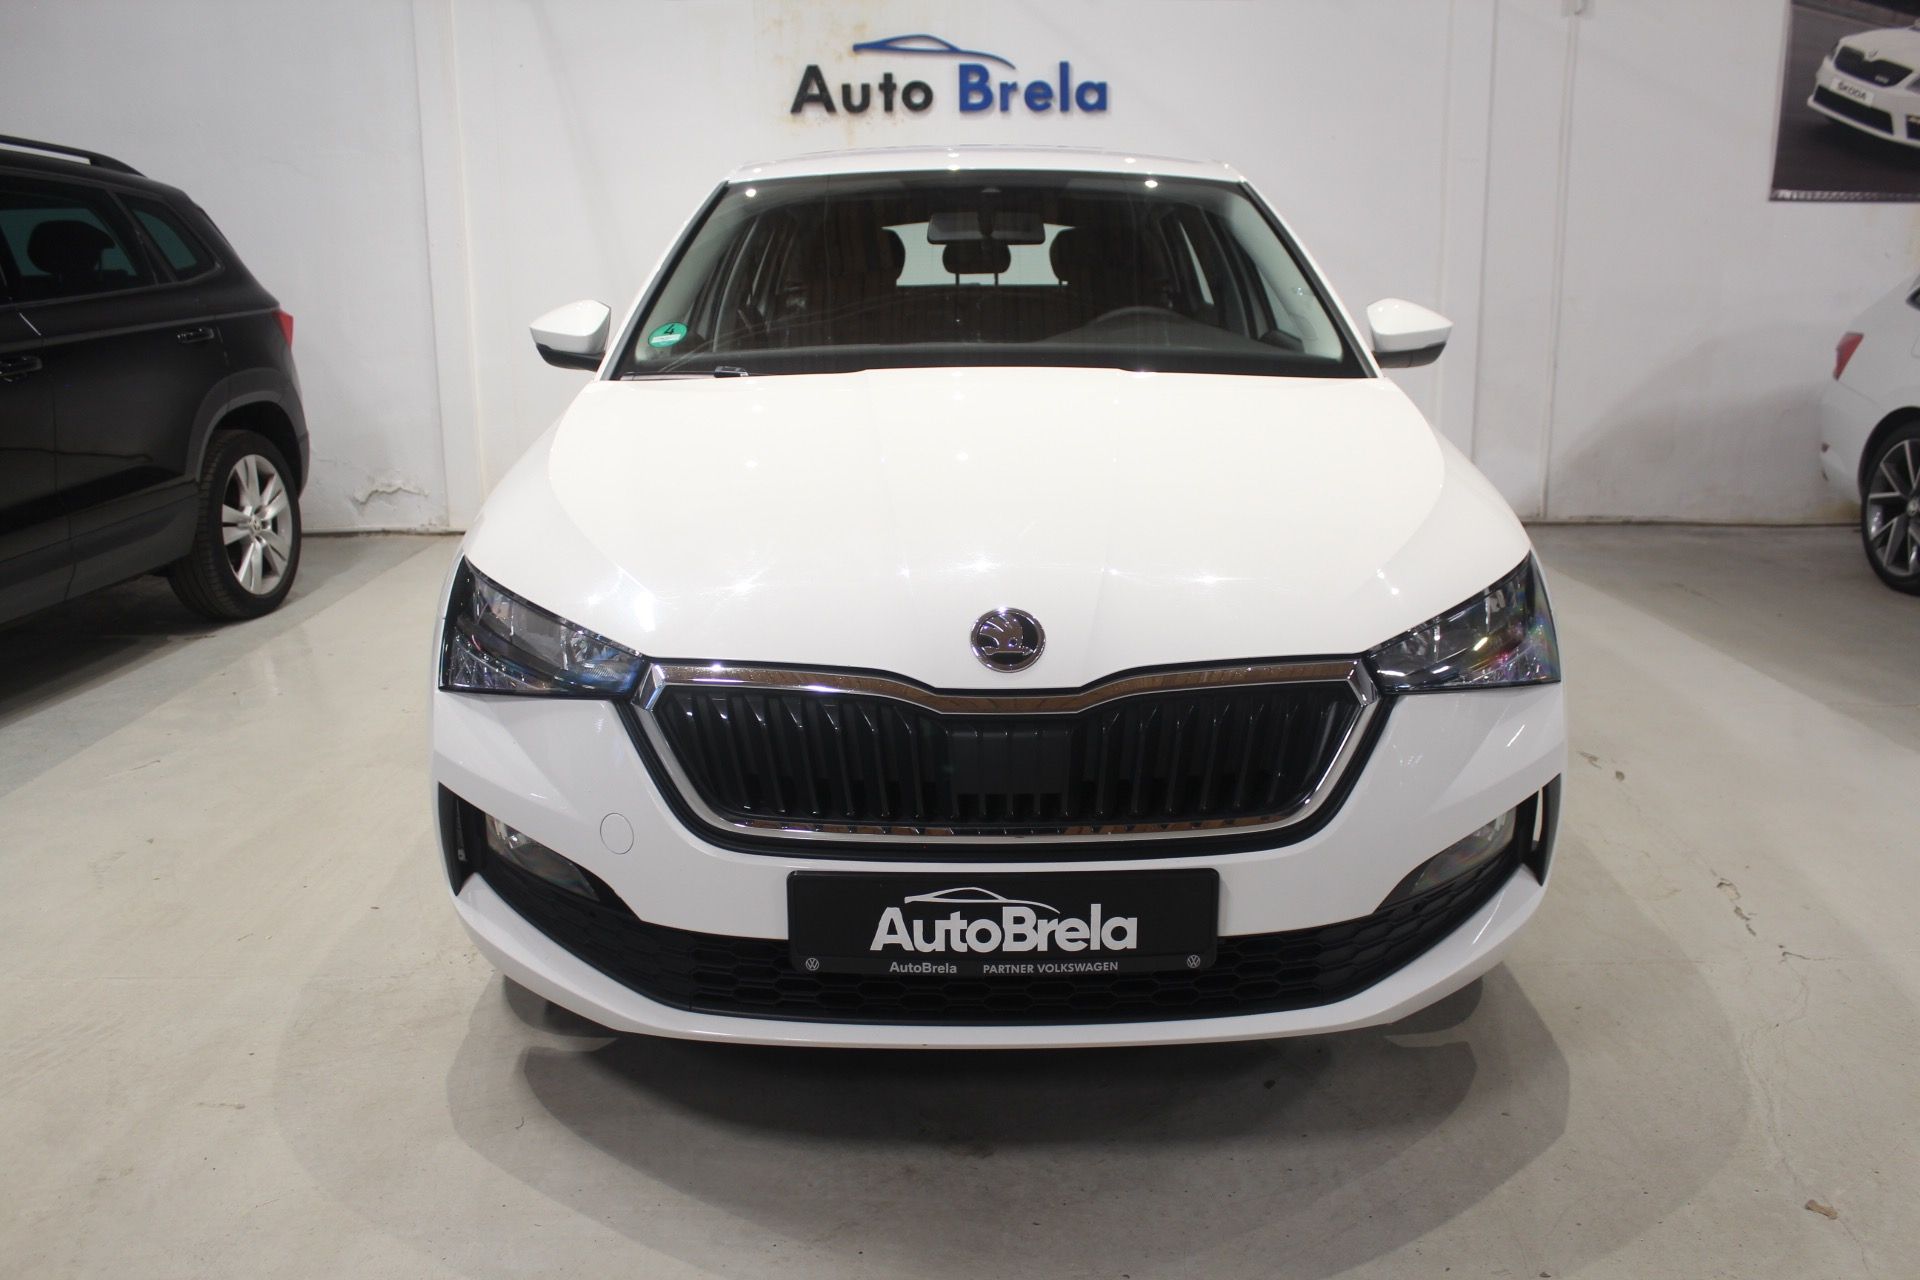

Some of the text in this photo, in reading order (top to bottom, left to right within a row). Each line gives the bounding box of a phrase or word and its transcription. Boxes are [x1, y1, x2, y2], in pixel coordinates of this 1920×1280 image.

[790, 61, 1108, 114] Auto Brela
[663, 323, 675, 335] 4
[869, 903, 1138, 953] AutoBrela
[889, 961, 958, 974] AutoBrela
[983, 961, 1119, 974] PARTNER VOLKSWAGEN
